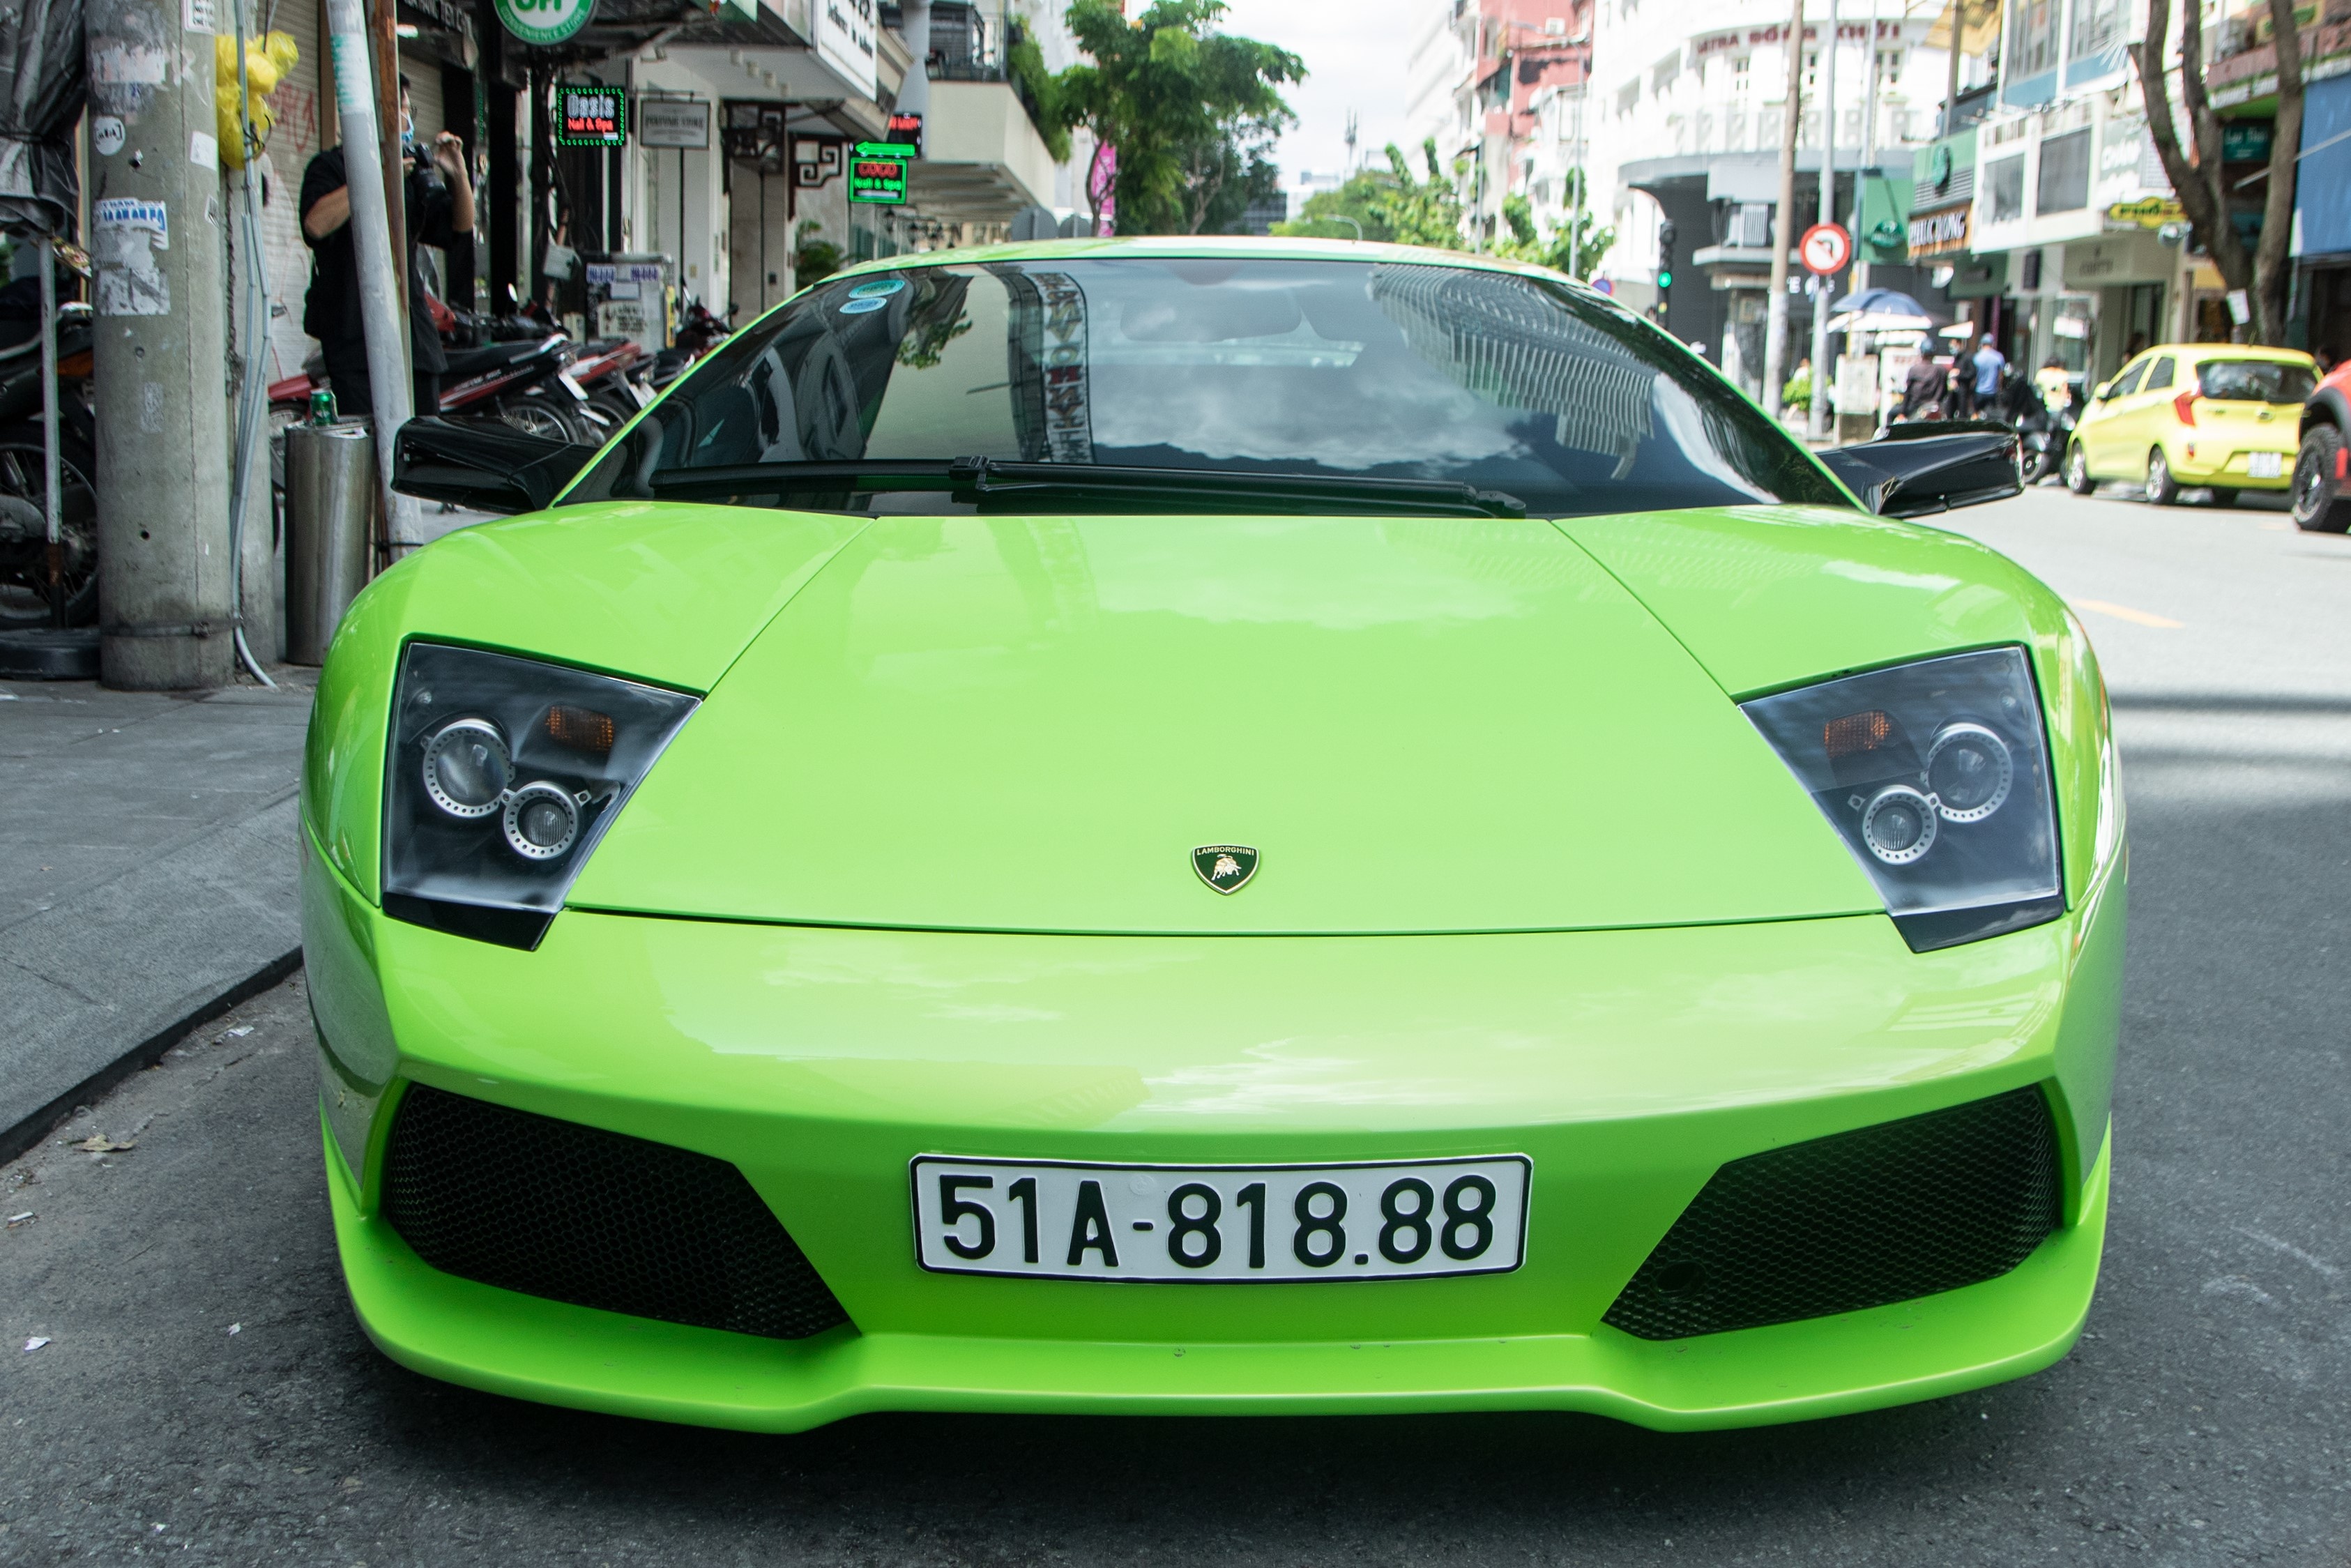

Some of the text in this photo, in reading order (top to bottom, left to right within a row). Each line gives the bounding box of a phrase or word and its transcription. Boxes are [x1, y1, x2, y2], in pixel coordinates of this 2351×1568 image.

[560, 8, 585, 33] STORE
[568, 93, 614, 119] Oasis
[586, 117, 594, 130] &
[1196, 846, 1254, 856] LAMBORGHINI
[939, 1173, 1497, 1268] 51A-818.88
